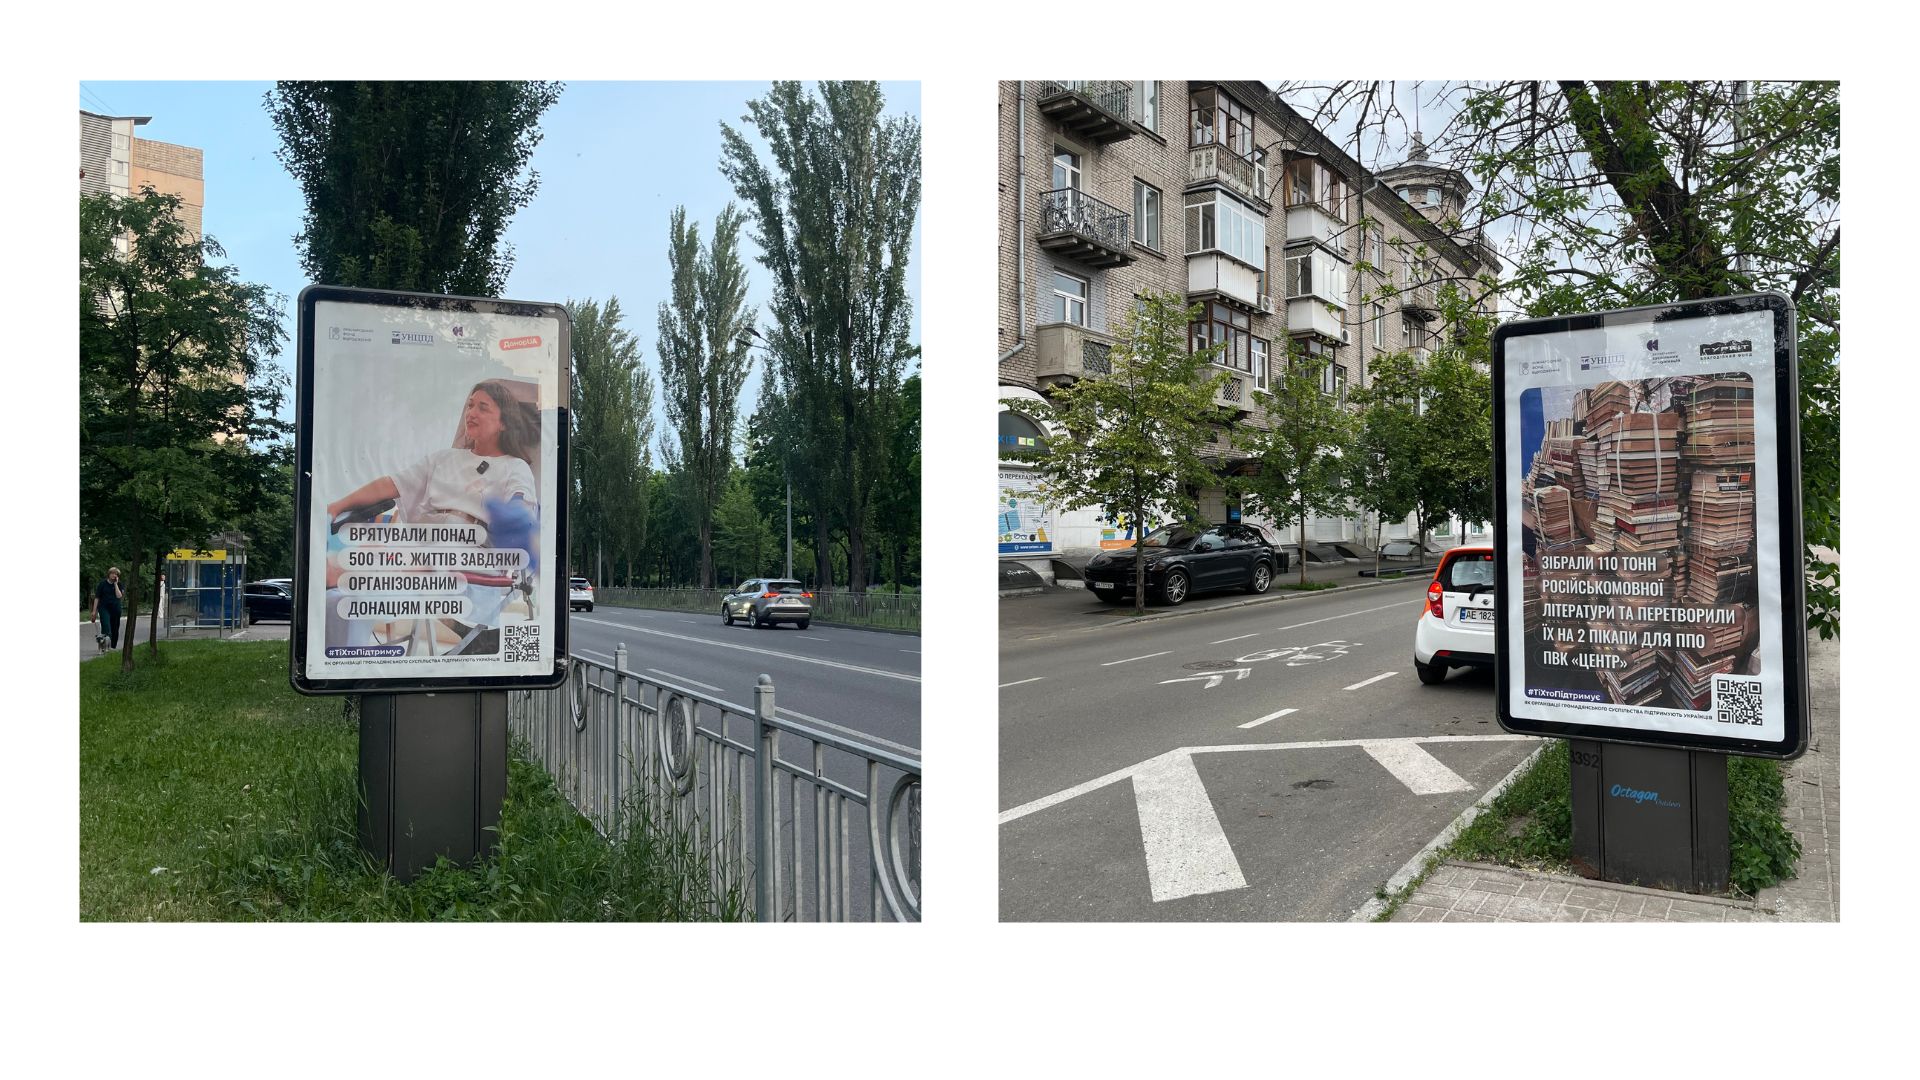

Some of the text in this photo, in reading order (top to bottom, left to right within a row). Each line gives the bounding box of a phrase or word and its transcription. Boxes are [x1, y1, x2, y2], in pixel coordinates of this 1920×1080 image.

[401, 333, 434, 343] УНЦПД
[349, 527, 476, 544] ВРЯТУВАЛИ ПОНАД
[349, 551, 520, 568] 500 ТИС. ЖИТТІВ ЗАВДЯКИ
[1541, 555, 1657, 572] ЗІБРАЛИ 110 ТОНН
[349, 576, 458, 591] ОРГАНІЗОВАНИМ
[1542, 577, 1664, 597] РОСІЙСЬКОМОВНОЇ
[348, 600, 463, 617] ДОНАЦІЯМ КРОВІ
[1466, 611, 1477, 620] AE
[1542, 603, 1736, 625] ЛІТЕРАТУРИ ТА ПЕРЕТВОРИЛИ
[1542, 623, 1706, 649] ЇХ НА 2 ПІКАПИ ДЛЯ ППО
[1543, 650, 1628, 669] ПВК «ЦЕНТР»
[1527, 688, 1601, 702] #ТіХтоПідтримує
[1561, 703, 1608, 712] ГРОМАДЯНСЬКОГО
[1608, 706, 1644, 714] СУСПІЛЬСТВА
[1644, 709, 1683, 718] ПІДТРИМУЮТЬ
[1610, 784, 1659, 804] Octagon
